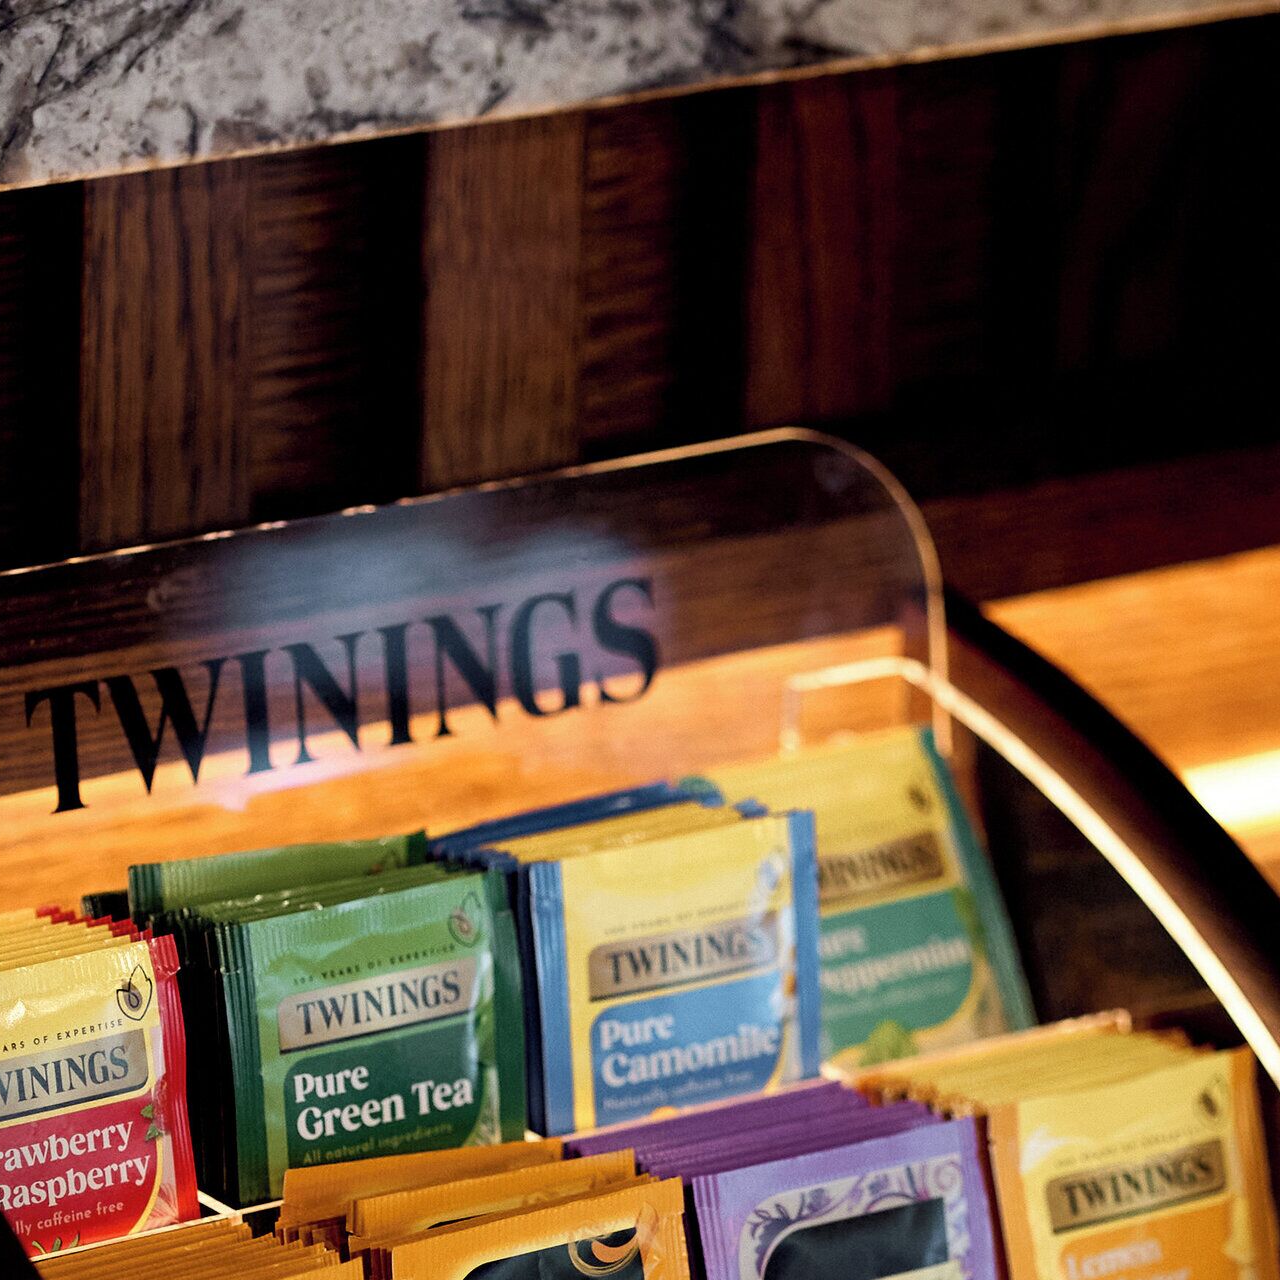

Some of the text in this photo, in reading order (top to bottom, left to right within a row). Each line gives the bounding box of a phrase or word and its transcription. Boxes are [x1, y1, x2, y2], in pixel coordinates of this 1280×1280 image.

[24, 576, 662, 814] TWININGS
[33, 1035, 49, 1046] OF
[57, 1018, 123, 1041] EXPERTISE
[296, 971, 462, 1036] TWININGS
[599, 1013, 675, 1051] Pure
[293, 1065, 370, 1104] Pure
[602, 1022, 780, 1088] Camomile
[297, 1078, 474, 1141] Green Tea
[37, 1210, 92, 1230] caffeine
[96, 1201, 124, 1215] free
[1063, 1156, 1211, 1217] TWININGS
